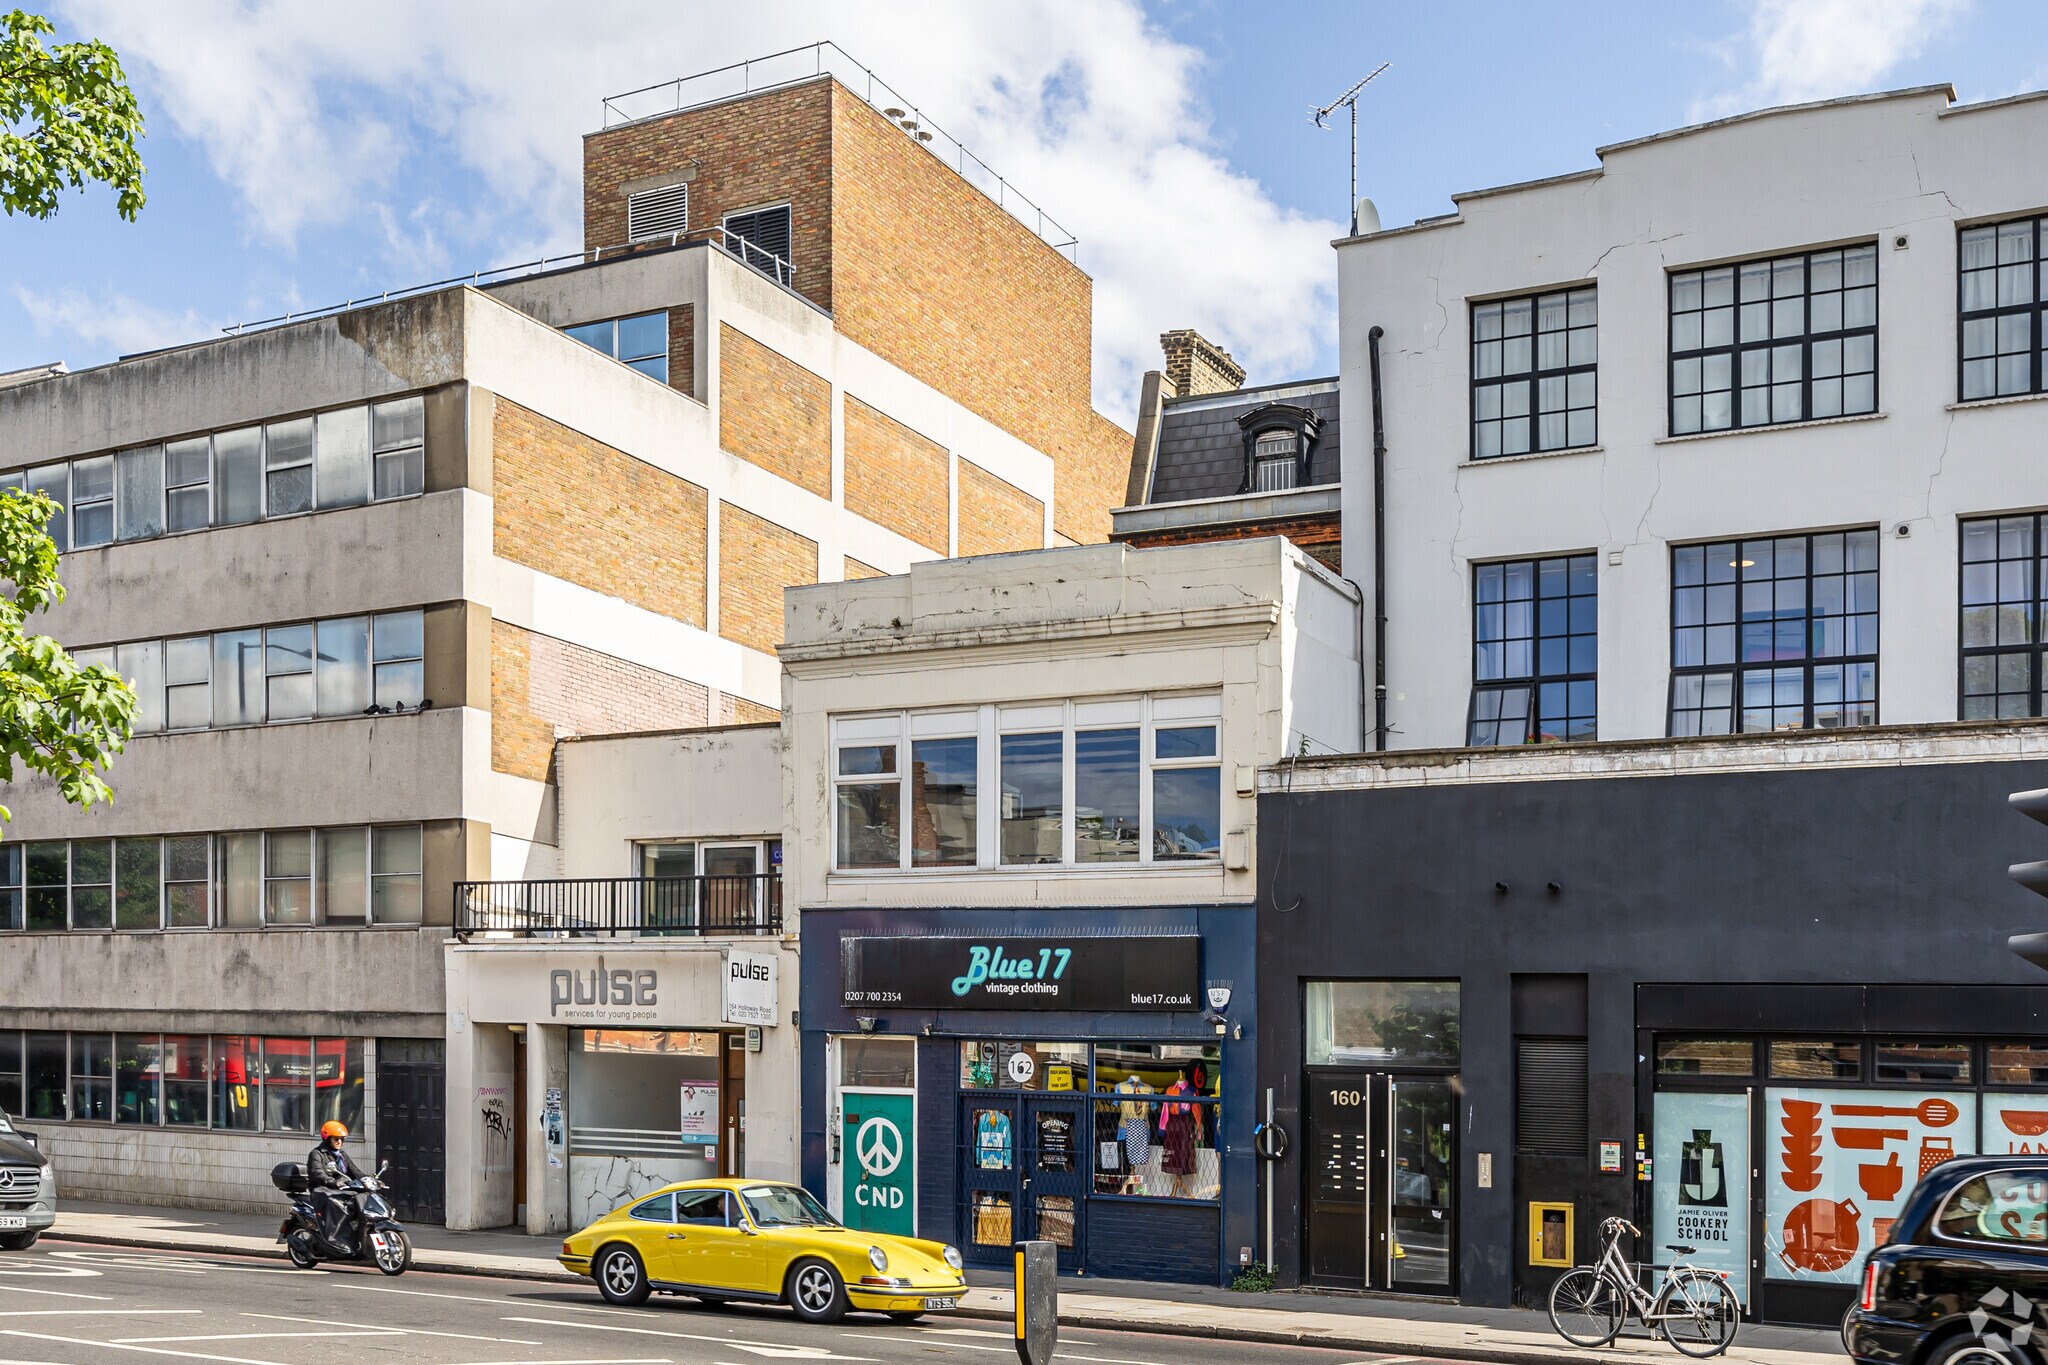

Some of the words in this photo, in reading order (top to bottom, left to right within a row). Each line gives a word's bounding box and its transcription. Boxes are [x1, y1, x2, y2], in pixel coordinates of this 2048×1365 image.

[731, 958, 769, 982] pulse
[951, 946, 1072, 996] Blue17
[551, 955, 657, 1017] pulse
[986, 983, 1019, 995] vintage
[1021, 982, 1058, 996] clothing
[845, 992, 864, 1001] 0207
[866, 992, 880, 1001] 700
[882, 992, 902, 1002] 2354
[1131, 993, 1192, 1004] blue17.co.uk
[564, 1010, 594, 1018] services
[596, 1010, 606, 1018] for
[608, 1011, 630, 1020] young
[632, 1010, 657, 1020] people
[738, 1010, 747, 1018] 020
[1010, 1060, 1032, 1075] 162
[1330, 1090, 1361, 1106] 160
[854, 1184, 904, 1209] CND
[1678, 1216, 1728, 1229] COOKERY
[376, 1237, 384, 1246] L
[1678, 1228, 1728, 1242] SCHOOL
